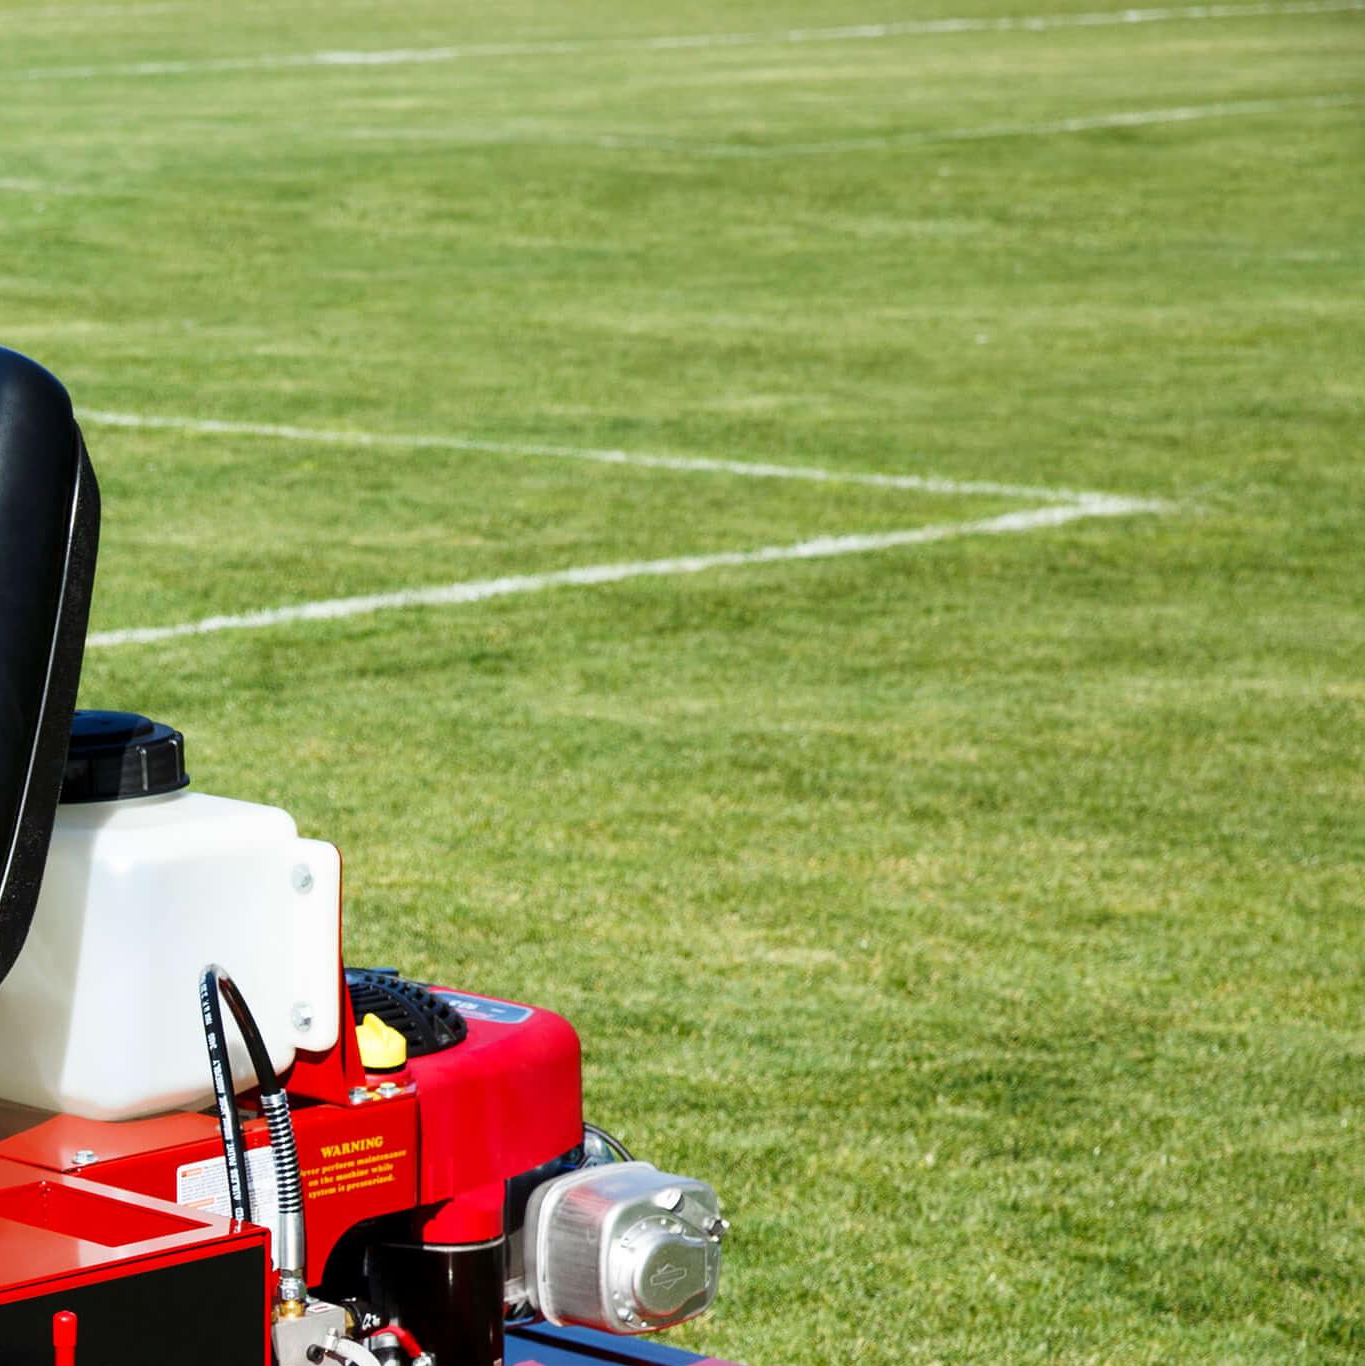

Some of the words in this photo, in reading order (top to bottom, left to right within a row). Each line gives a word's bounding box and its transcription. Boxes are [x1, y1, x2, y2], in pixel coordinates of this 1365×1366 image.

[321, 1136, 383, 1158] WARNING
[300, 1167, 320, 1177] ever
[322, 1160, 355, 1174] perform
[357, 1149, 407, 1165] maintenance
[321, 1176, 334, 1184] the
[336, 1168, 369, 1181] machine
[371, 1163, 394, 1173] while
[309, 1187, 336, 1199] system
[338, 1183, 345, 1192] is
